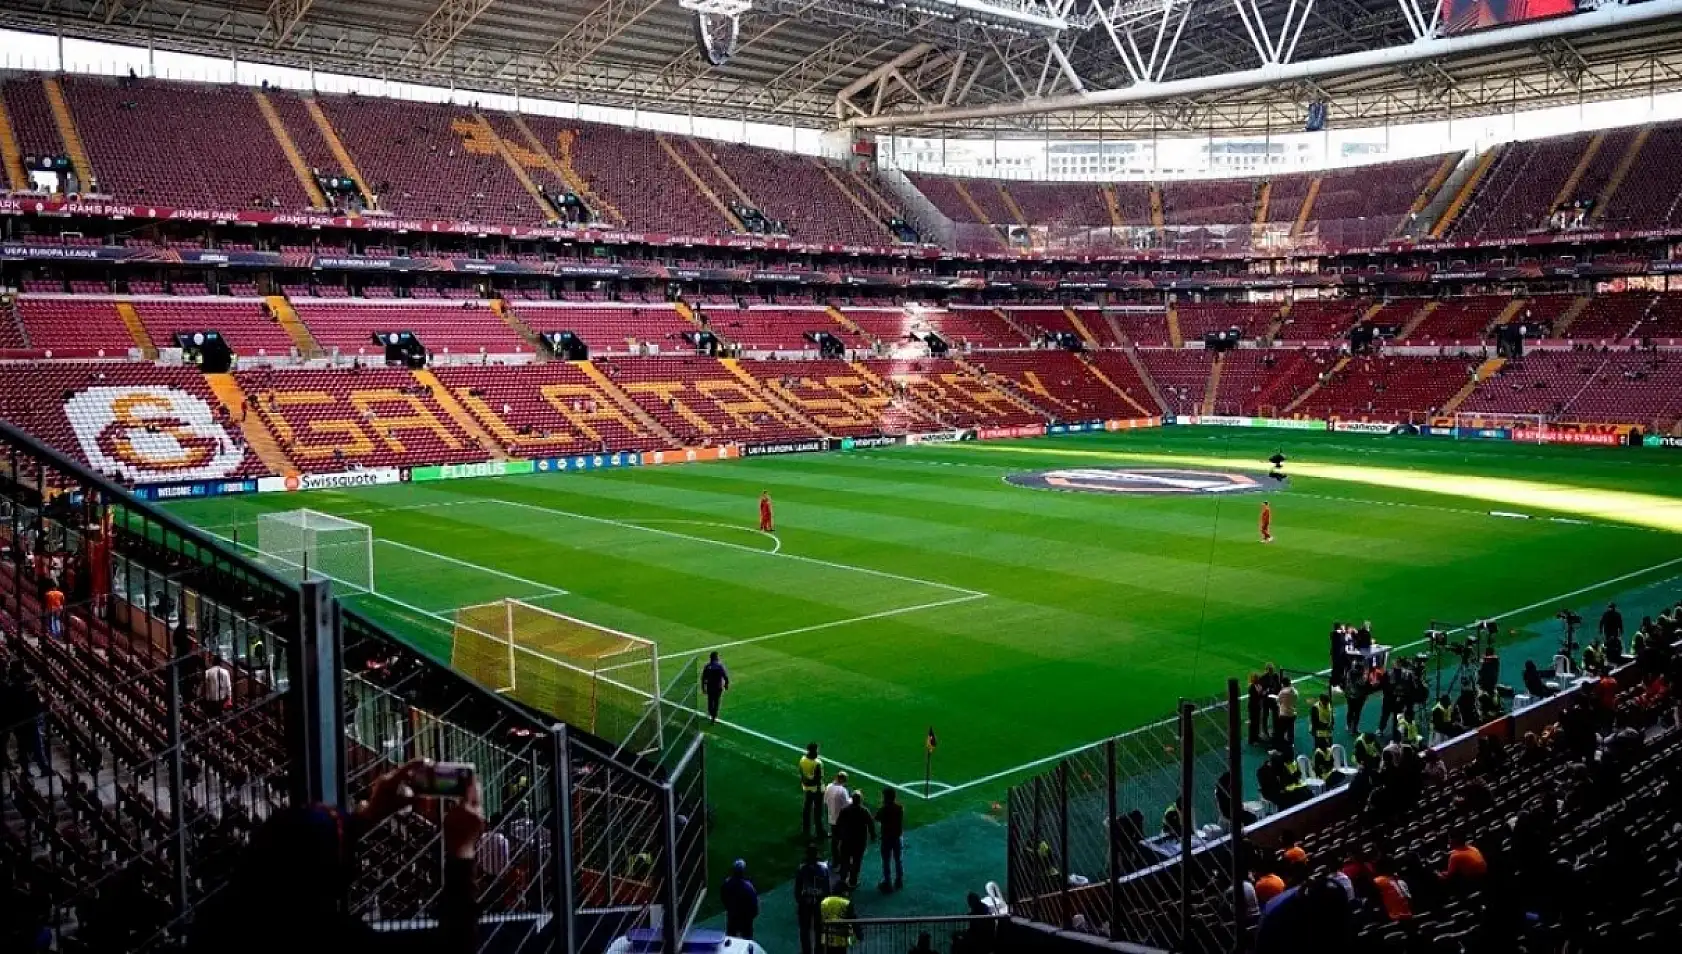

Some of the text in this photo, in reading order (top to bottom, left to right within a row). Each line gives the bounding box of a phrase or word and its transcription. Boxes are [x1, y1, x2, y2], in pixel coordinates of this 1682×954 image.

[70, 203, 135, 215] RAMS PARK
[180, 209, 239, 220] RAMS PARK
[280, 215, 335, 225] RAMS PARK
[4, 247, 97, 258] UEFA EUROPA LEAGUE
[1574, 433, 1614, 443] STRAUSS
[749, 442, 819, 454] UEFA EUROPA LEAGUE
[442, 462, 506, 477] FLIXBUS
[302, 473, 377, 488] Swissquote
